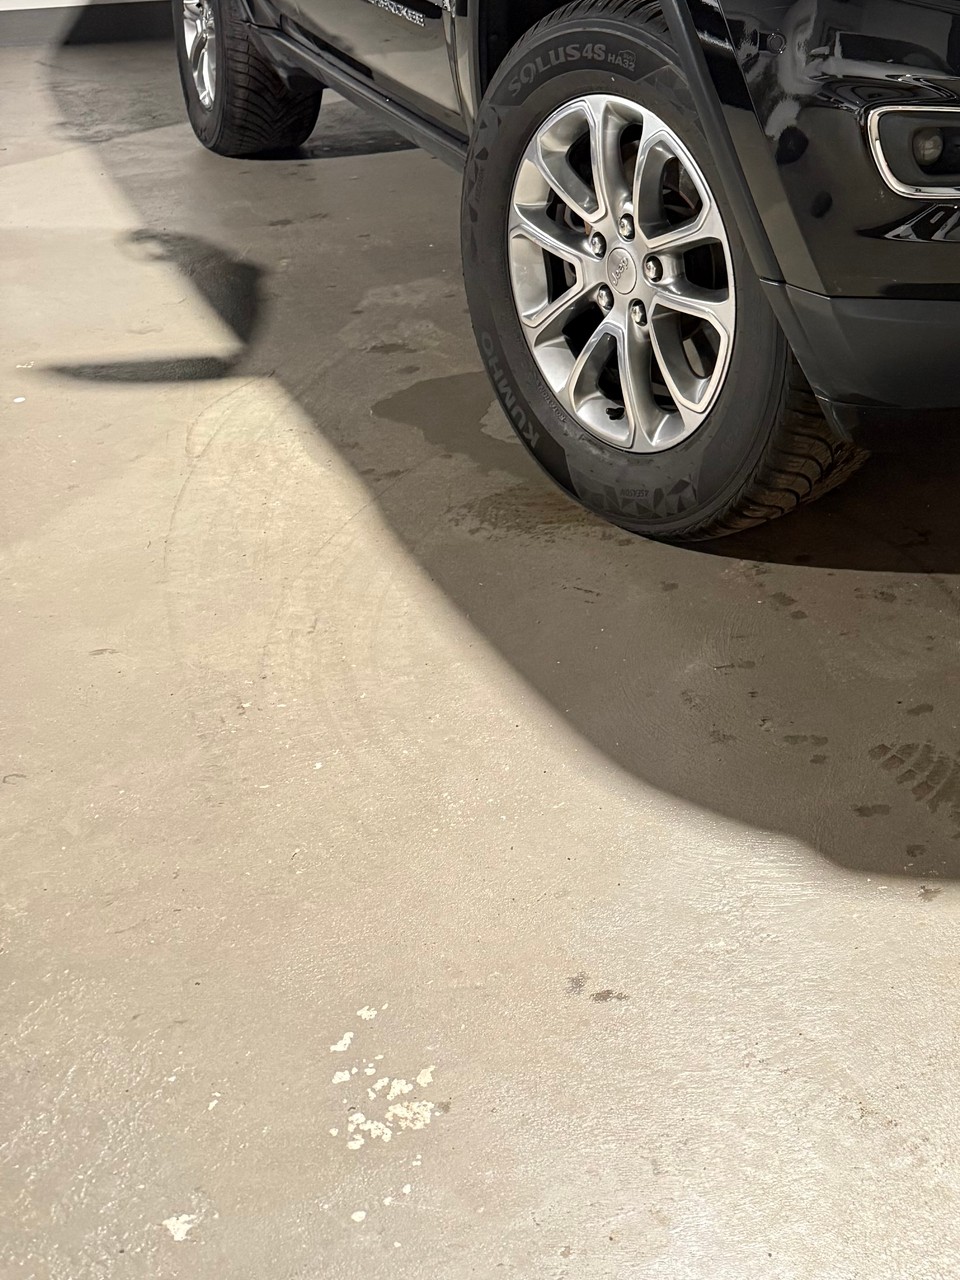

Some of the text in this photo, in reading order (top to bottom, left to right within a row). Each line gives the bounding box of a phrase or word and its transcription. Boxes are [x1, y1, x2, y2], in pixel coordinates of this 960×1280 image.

[607, 53, 635, 71] HA32
[611, 257, 629, 287] Jeep
[481, 331, 539, 448] KUMHO
